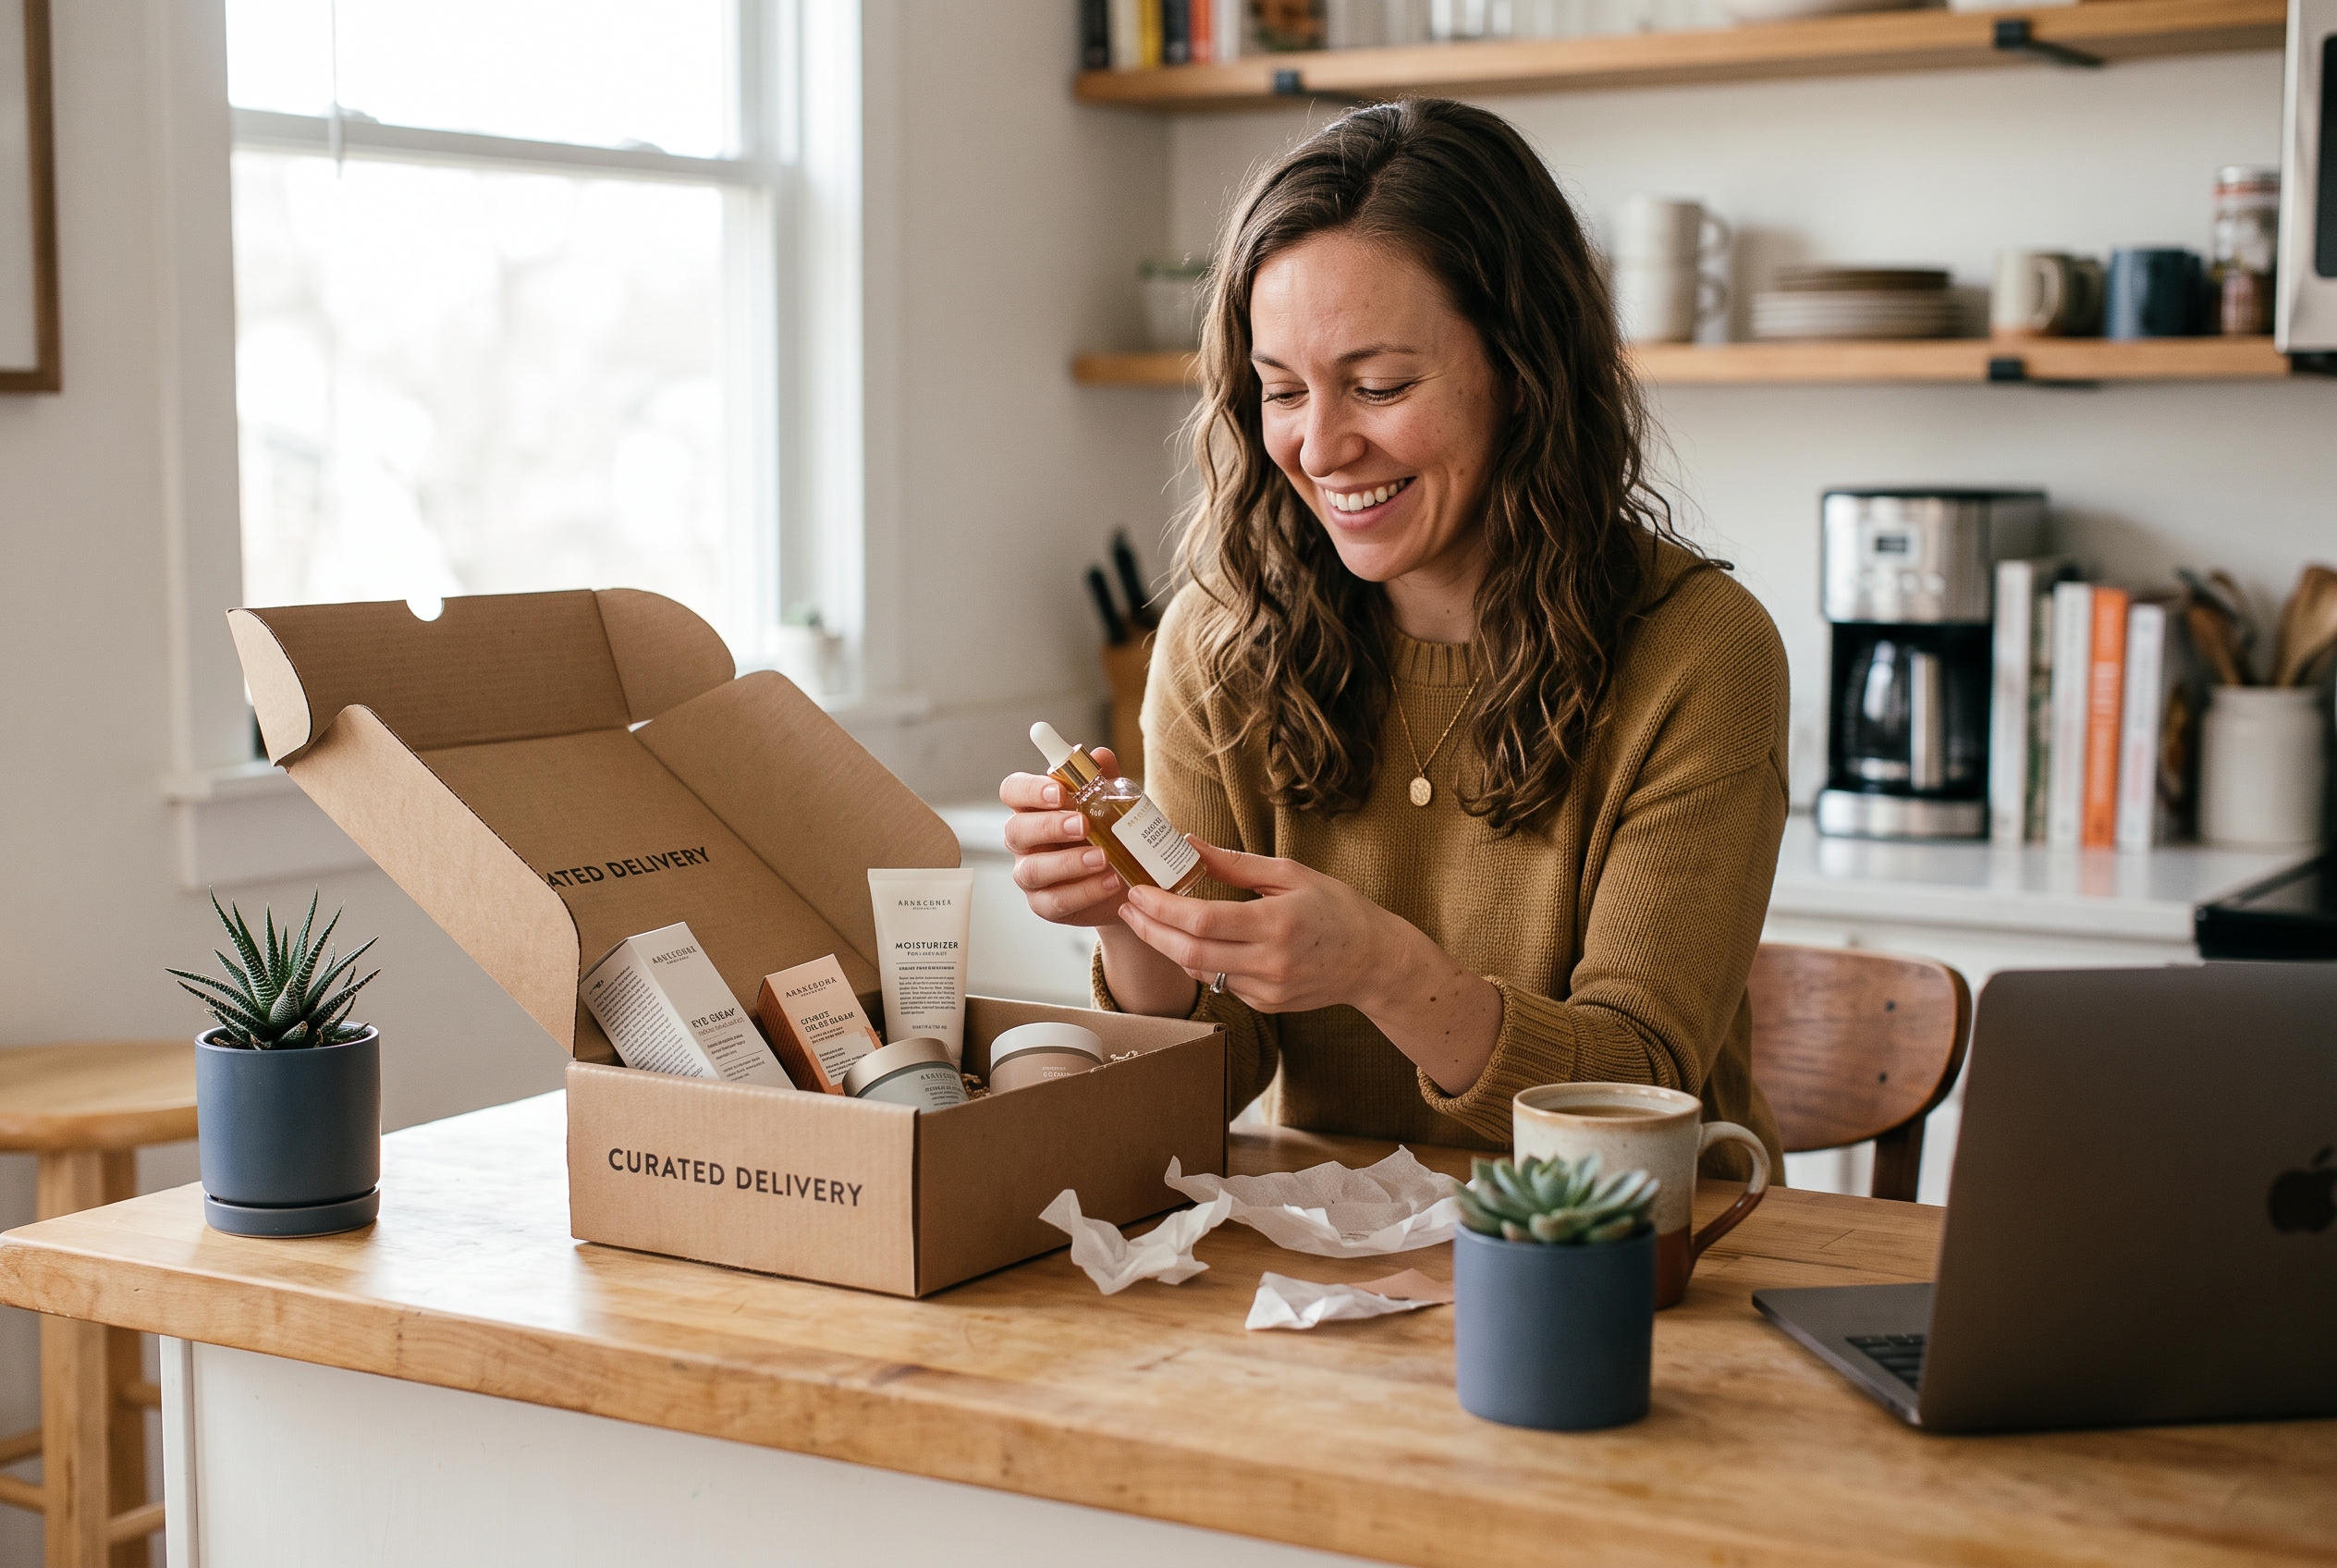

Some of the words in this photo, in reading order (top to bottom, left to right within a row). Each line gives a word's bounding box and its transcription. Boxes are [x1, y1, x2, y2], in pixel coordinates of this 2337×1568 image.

[605, 846, 711, 878] DELIVERY
[895, 941, 959, 949] MOISTURIZER
[608, 1147, 726, 1186] CURATED
[736, 1166, 863, 1207] DELIVERY
